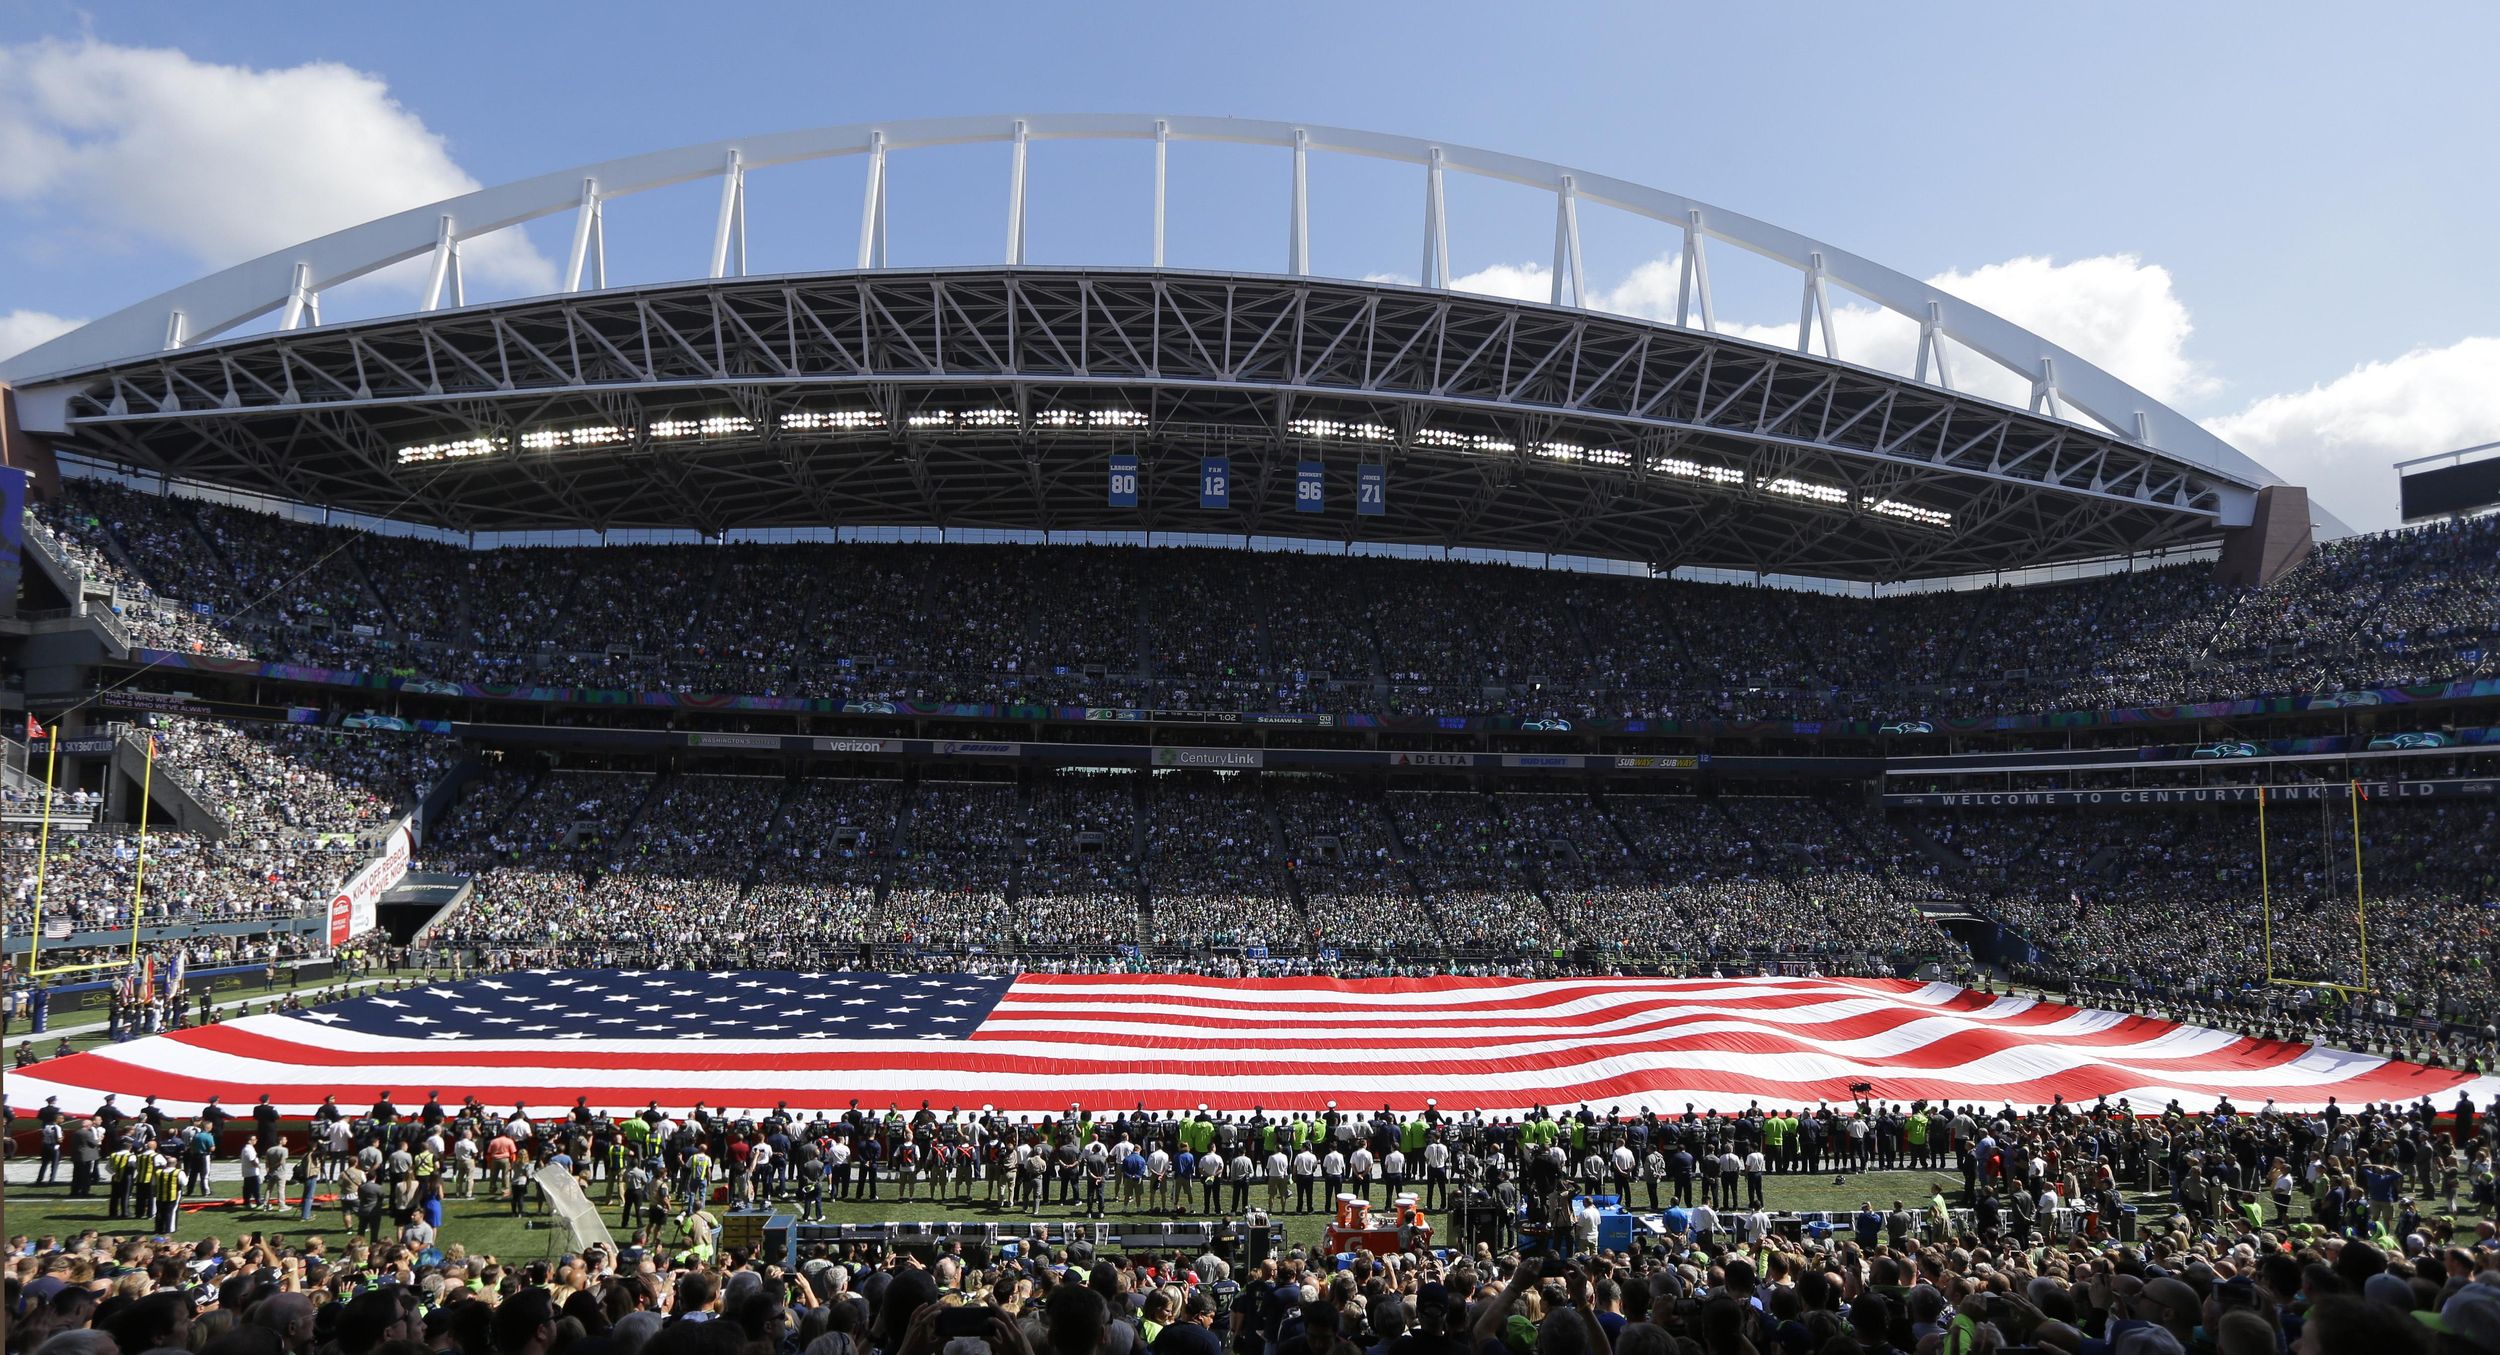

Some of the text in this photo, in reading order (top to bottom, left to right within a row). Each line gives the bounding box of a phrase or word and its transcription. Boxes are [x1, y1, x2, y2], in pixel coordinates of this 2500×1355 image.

[1111, 474, 1135, 494] 80
[1205, 476, 1225, 496] 12
[1298, 481, 1322, 500] 96
[1361, 484, 1381, 503] 71
[196, 604, 209, 614] 12
[409, 632, 421, 641] 12
[2461, 651, 2477, 662] 12
[841, 659, 851, 668] 12
[1056, 666, 1066, 675] 12
[105, 692, 185, 705] THAT'S WHO WE ARE
[1279, 689, 1287, 697] 12
[105, 699, 212, 714] THAT'S WHO WE'VE ALWAYS
[1218, 714, 1237, 722] 1:02
[1257, 716, 1303, 724] SEAHAWKS
[94, 740, 113, 751] CLUB
[701, 737, 751, 745] WASHINGTON'S
[830, 740, 880, 752] verizon
[959, 743, 1010, 752] BOEING
[1180, 751, 1254, 765] CenturyLink
[1415, 754, 1467, 765] DELTA
[1540, 758, 1566, 766] LIGHT
[1618, 757, 1653, 767] SUBWAY
[1660, 758, 1696, 768] SUBWAY
[1942, 783, 2435, 806] WELCOME TO CENTURYLINK FIELD
[352, 845, 405, 901] KICK OFF REDBOX
[369, 874, 389, 898] MOVIE
[2028, 947, 2037, 962] 12
[1358, 1210, 1366, 1219] G
[1344, 1236, 1363, 1253] G
